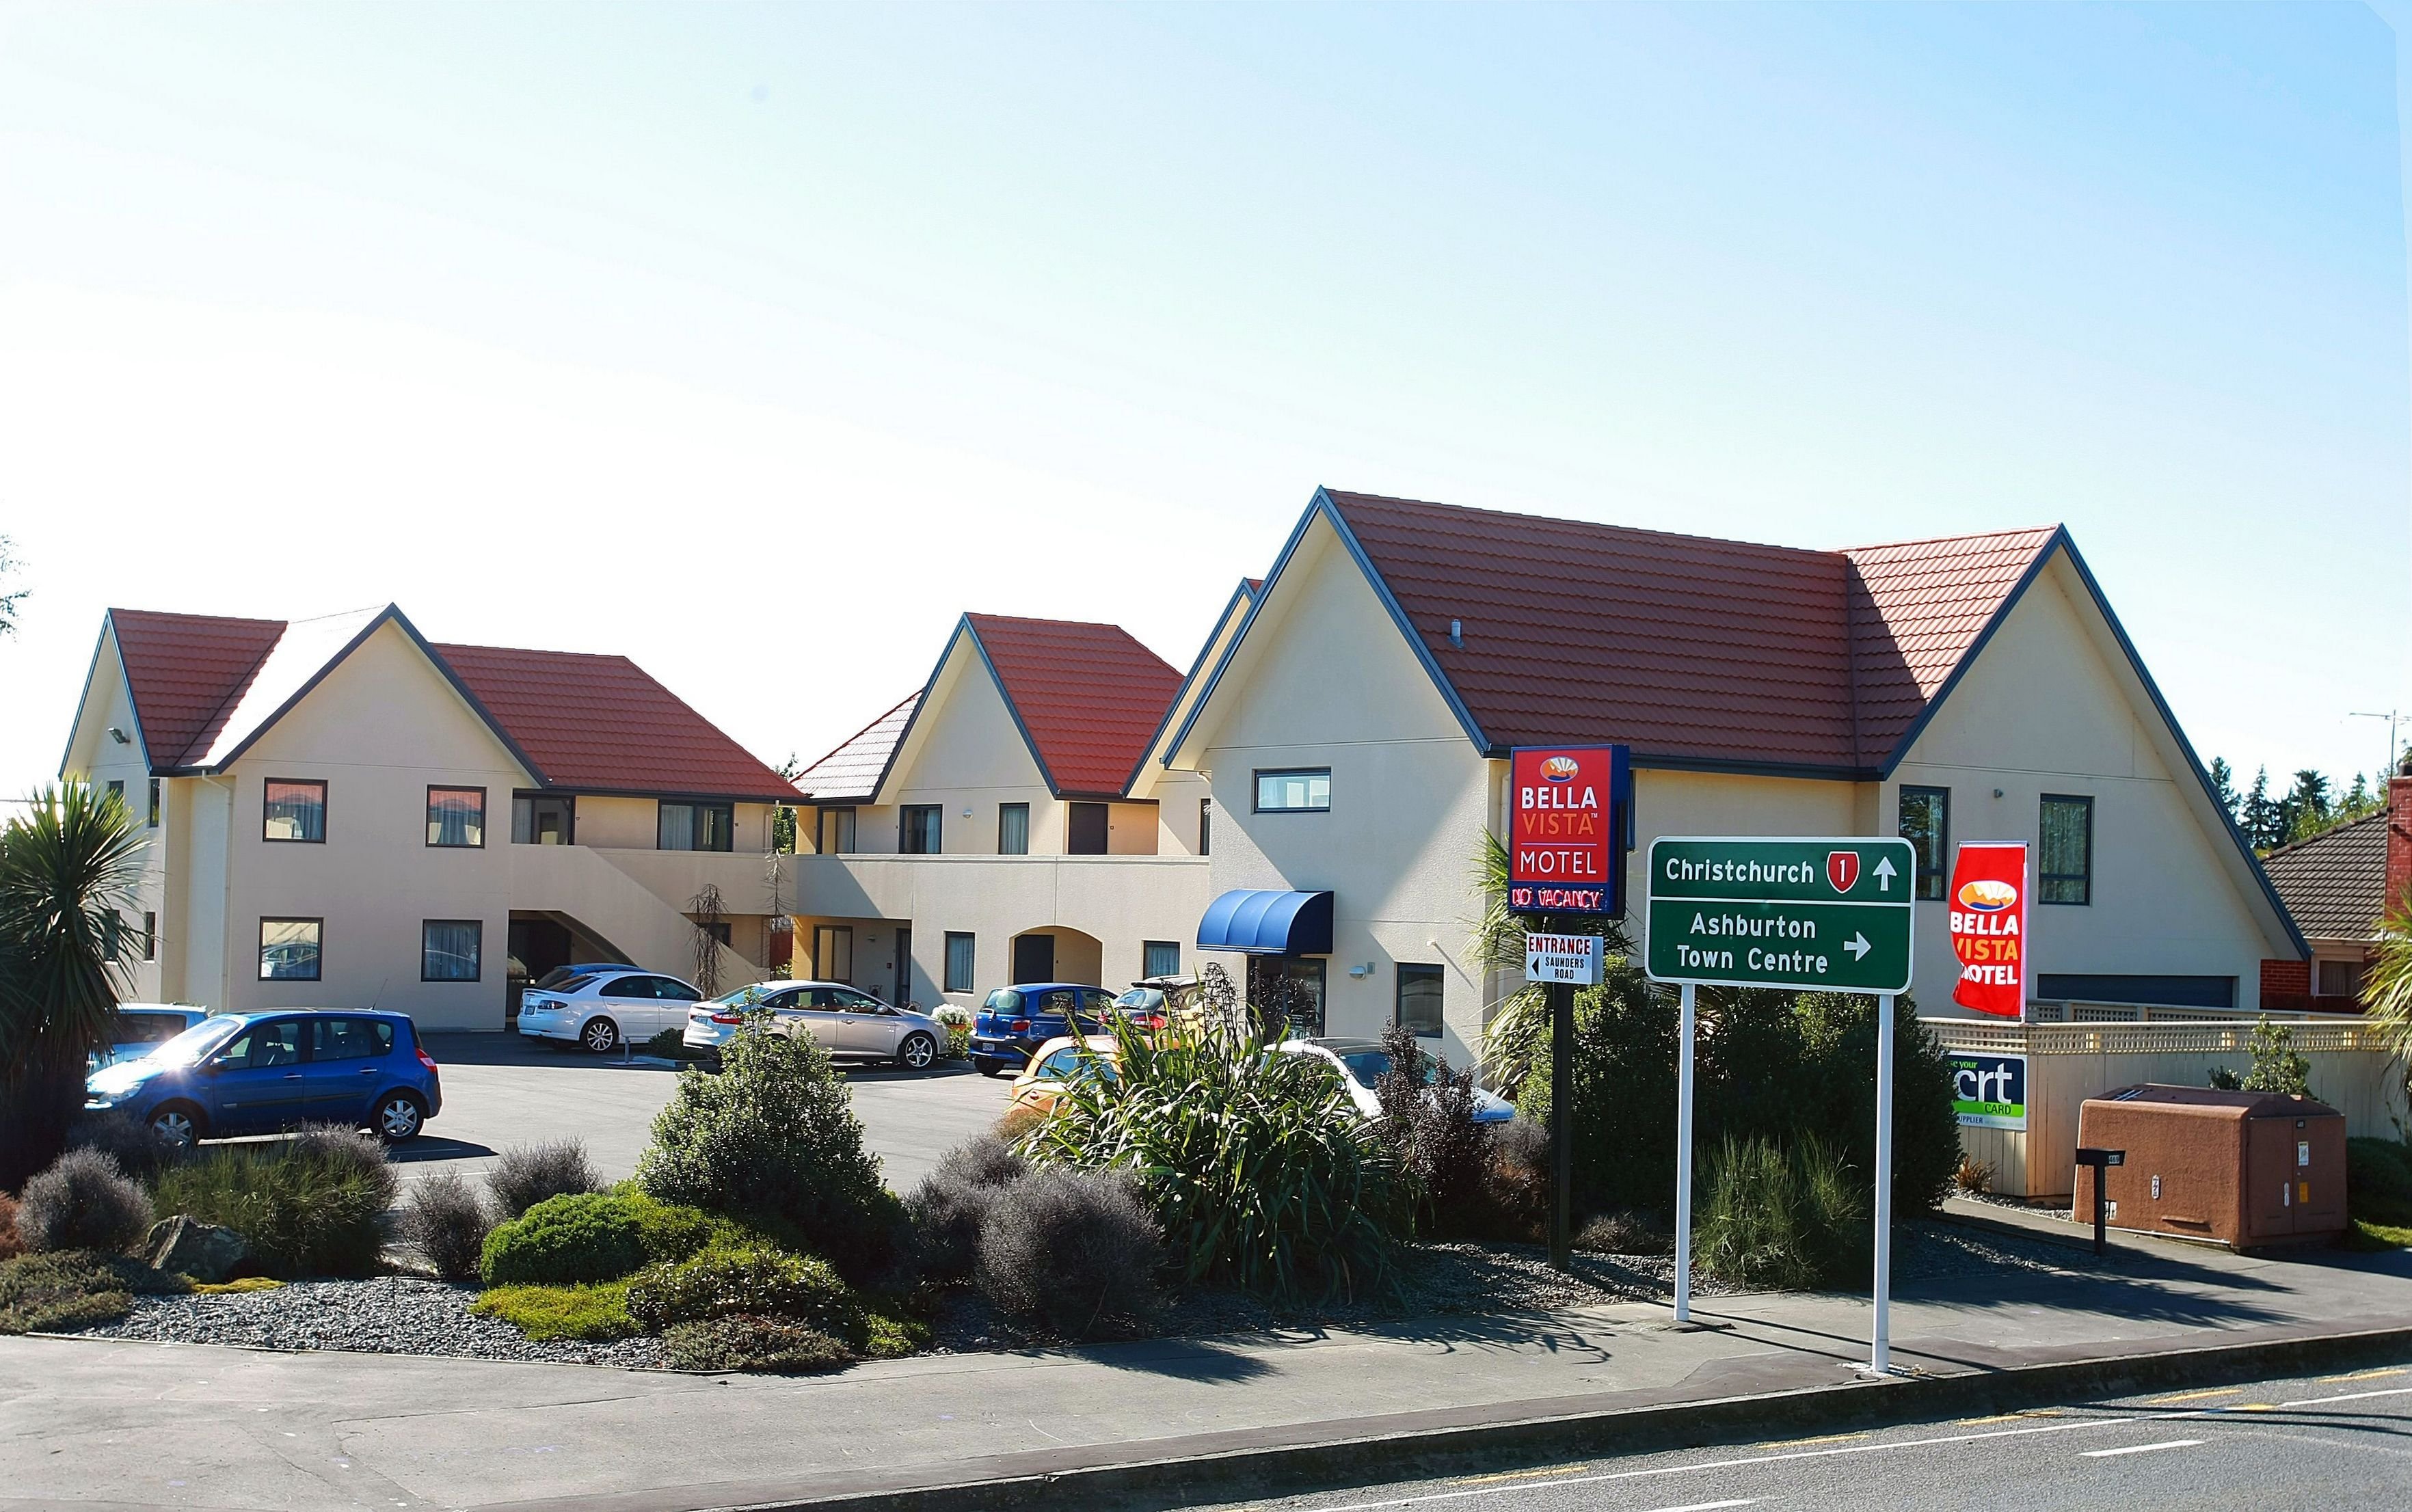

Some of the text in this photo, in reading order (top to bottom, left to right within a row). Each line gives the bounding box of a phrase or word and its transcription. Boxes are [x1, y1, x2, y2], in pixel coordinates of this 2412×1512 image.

[1521, 786, 1598, 809] BELLA
[1522, 812, 1594, 835] VISTA
[1520, 850, 1597, 874] MOTEL
[1666, 857, 1845, 884] Christchurch 1
[1538, 888, 1600, 908] VACANCY
[1690, 912, 1817, 939] Ashburton
[1950, 910, 2020, 936] BELLA
[1528, 936, 1591, 956] ENTRANCE
[1545, 956, 1585, 969] SAUNDERS
[1677, 945, 1829, 974] Town Centre
[1554, 969, 1574, 980] ROAD
[1959, 1061, 1978, 1069] your
[1953, 1062, 2013, 1105] crt
[1957, 1115, 1983, 1124] UPPLIER
[1984, 1103, 2011, 1115] CARD
